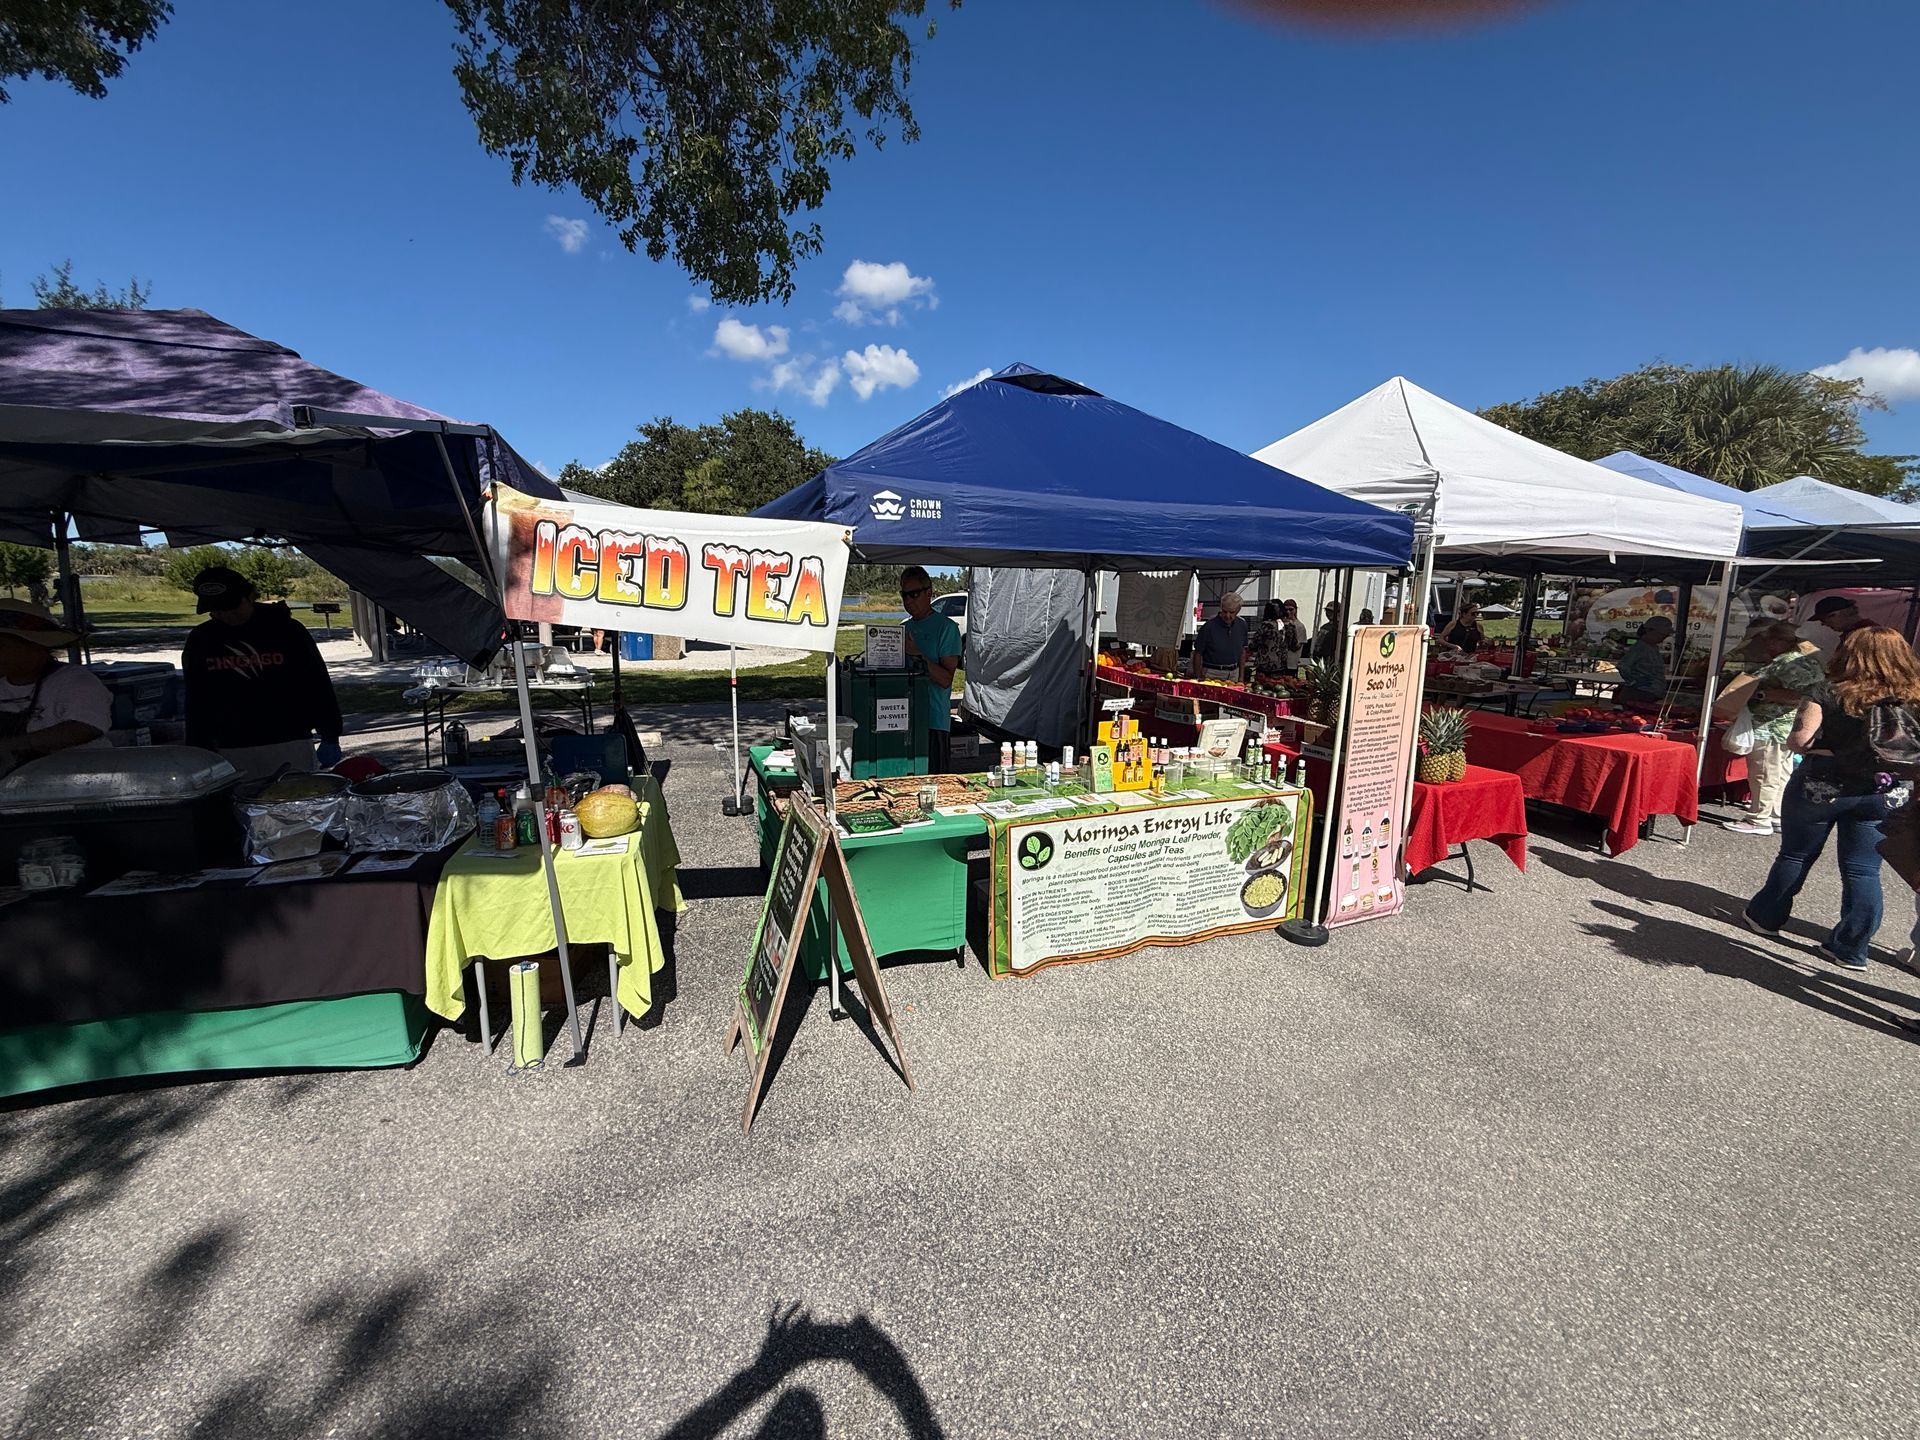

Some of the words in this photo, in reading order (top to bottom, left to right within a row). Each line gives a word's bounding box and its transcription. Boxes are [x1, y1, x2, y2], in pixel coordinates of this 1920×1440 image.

[910, 499, 942, 510] CROWN
[910, 509, 942, 520] SHADES
[530, 520, 690, 611] ICED
[702, 543, 829, 626] TEA
[1366, 662, 1404, 676] Moringa
[1366, 679, 1384, 690] Seed
[1386, 677, 1397, 690] Oil
[1064, 824, 1140, 845] Moringa
[1143, 816, 1200, 834] Energy
[1204, 808, 1232, 825] Life
[1064, 848, 1100, 860] Benefits
[1102, 844, 1112, 854] of
[1112, 842, 1136, 854] using
[1138, 837, 1170, 848] Moringa
[1172, 833, 1192, 844] Leaf
[1192, 830, 1221, 842] Powder,
[1107, 851, 1146, 864] Capsules
[1148, 847, 1162, 857] and
[1164, 843, 1184, 855] Teas
[1080, 867, 1108, 875] superfood
